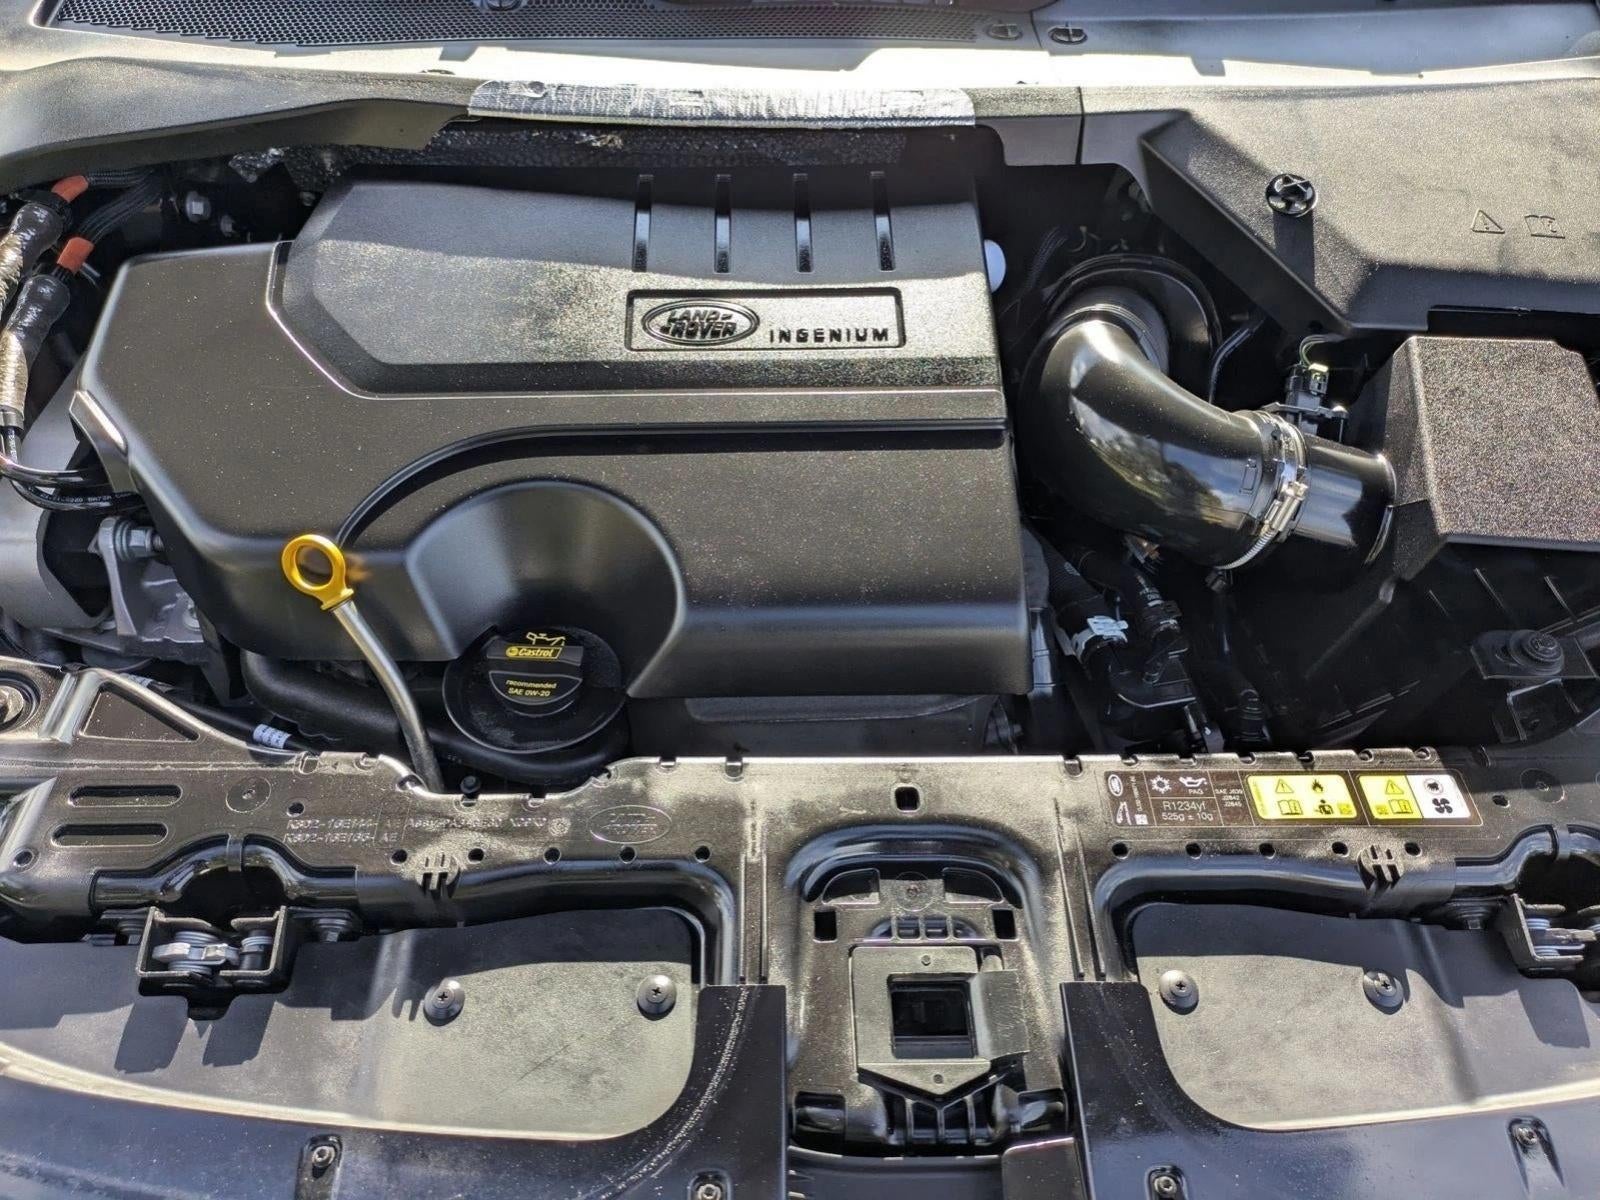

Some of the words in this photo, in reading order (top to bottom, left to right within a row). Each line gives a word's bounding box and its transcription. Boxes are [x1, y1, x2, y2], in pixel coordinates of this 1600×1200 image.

[769, 327, 889, 344] INGENIUM
[518, 647, 554, 657] Castrol
[505, 680, 557, 689] recommended
[508, 688, 523, 696] SAE
[525, 688, 551, 697] 0W-20
[1162, 801, 1206, 812] R1234yf
[1161, 813, 1185, 822] 525g
[1196, 812, 1214, 822] 10g
